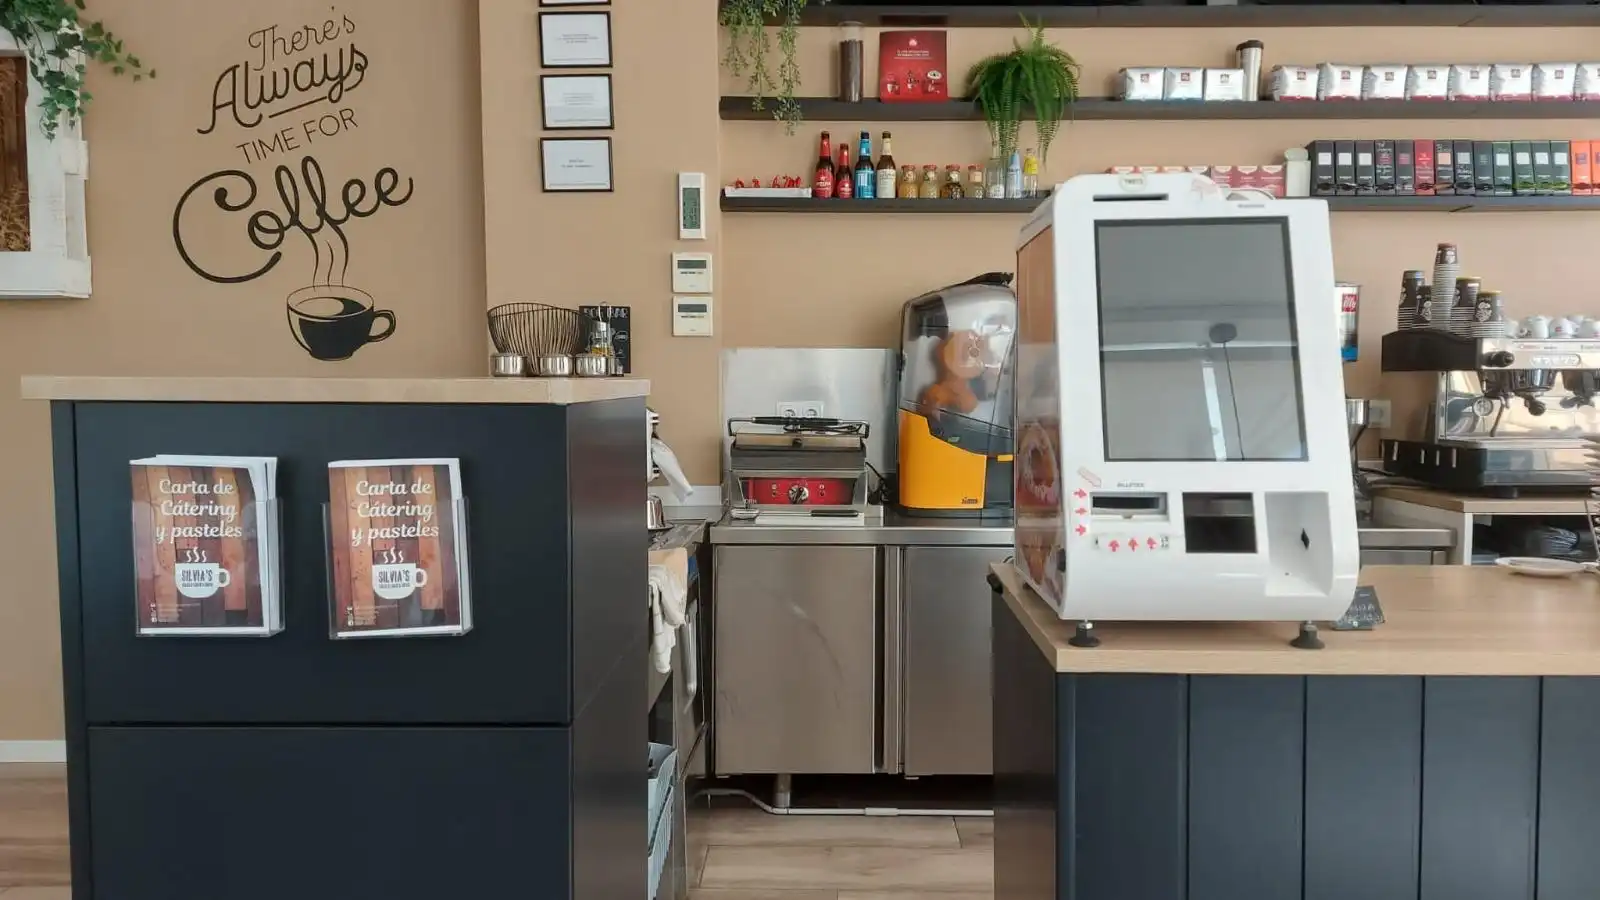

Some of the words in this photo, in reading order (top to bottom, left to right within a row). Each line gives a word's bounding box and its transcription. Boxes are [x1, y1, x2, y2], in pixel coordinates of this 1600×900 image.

[248, 5, 356, 72] There's
[197, 43, 369, 134] Always
[236, 126, 301, 165] TIME
[302, 107, 359, 145] FOR
[172, 155, 414, 284] Coffee
[159, 479, 210, 495] Carta
[213, 477, 234, 495] de
[355, 480, 408, 497] Carta
[411, 476, 432, 495] de
[160, 499, 238, 523] Cátering
[356, 500, 434, 523] Cátering
[155, 526, 166, 545] y
[169, 520, 243, 544] pasteles
[351, 528, 363, 547] y
[367, 520, 440, 546] pasteles
[181, 568, 214, 582] SILVIA'S
[378, 569, 411, 584] SILVIA'S
